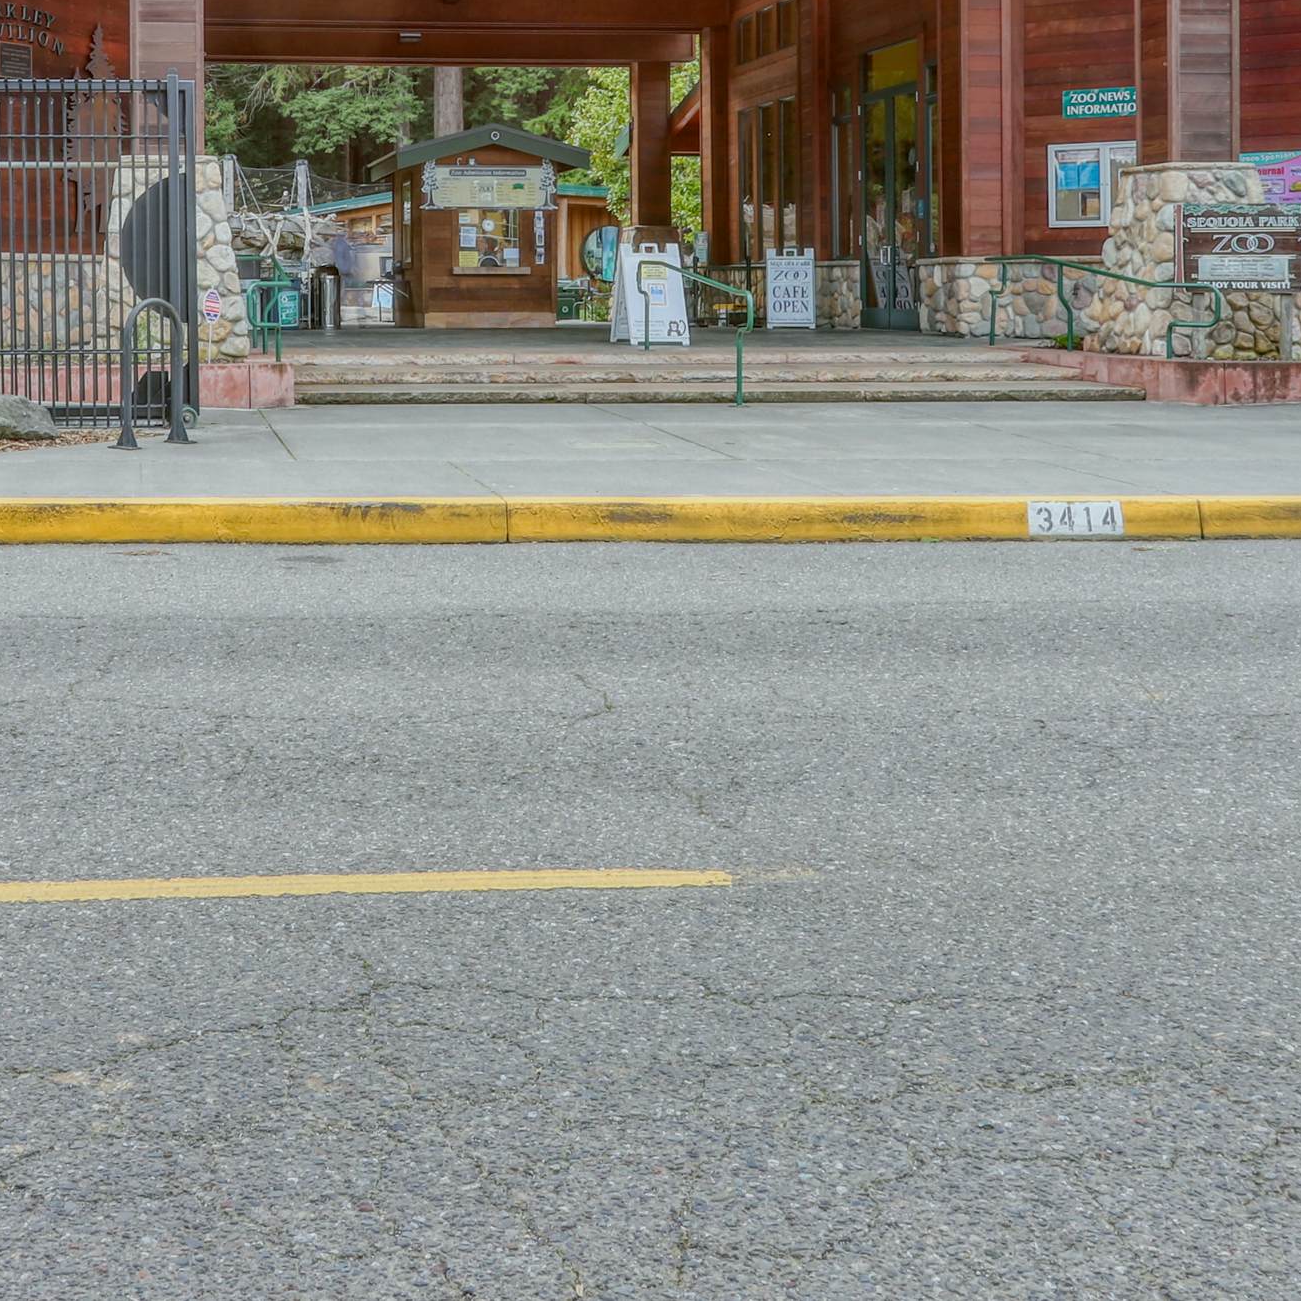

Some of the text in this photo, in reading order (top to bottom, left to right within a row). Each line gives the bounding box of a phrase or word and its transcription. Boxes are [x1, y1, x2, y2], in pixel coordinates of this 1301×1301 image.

[1070, 92, 1097, 103] ZOO
[1099, 90, 1130, 102] NEWS
[1066, 102, 1137, 115] INFORMATIO
[1187, 216, 1299, 228] SEQUOIA PARK
[1212, 233, 1275, 254] ZOO
[774, 270, 808, 281] ZOO
[1231, 281, 1259, 289] YOUR
[772, 285, 809, 299] CAFE
[772, 299, 809, 313] OPEN
[1035, 506, 1117, 533] 3414
